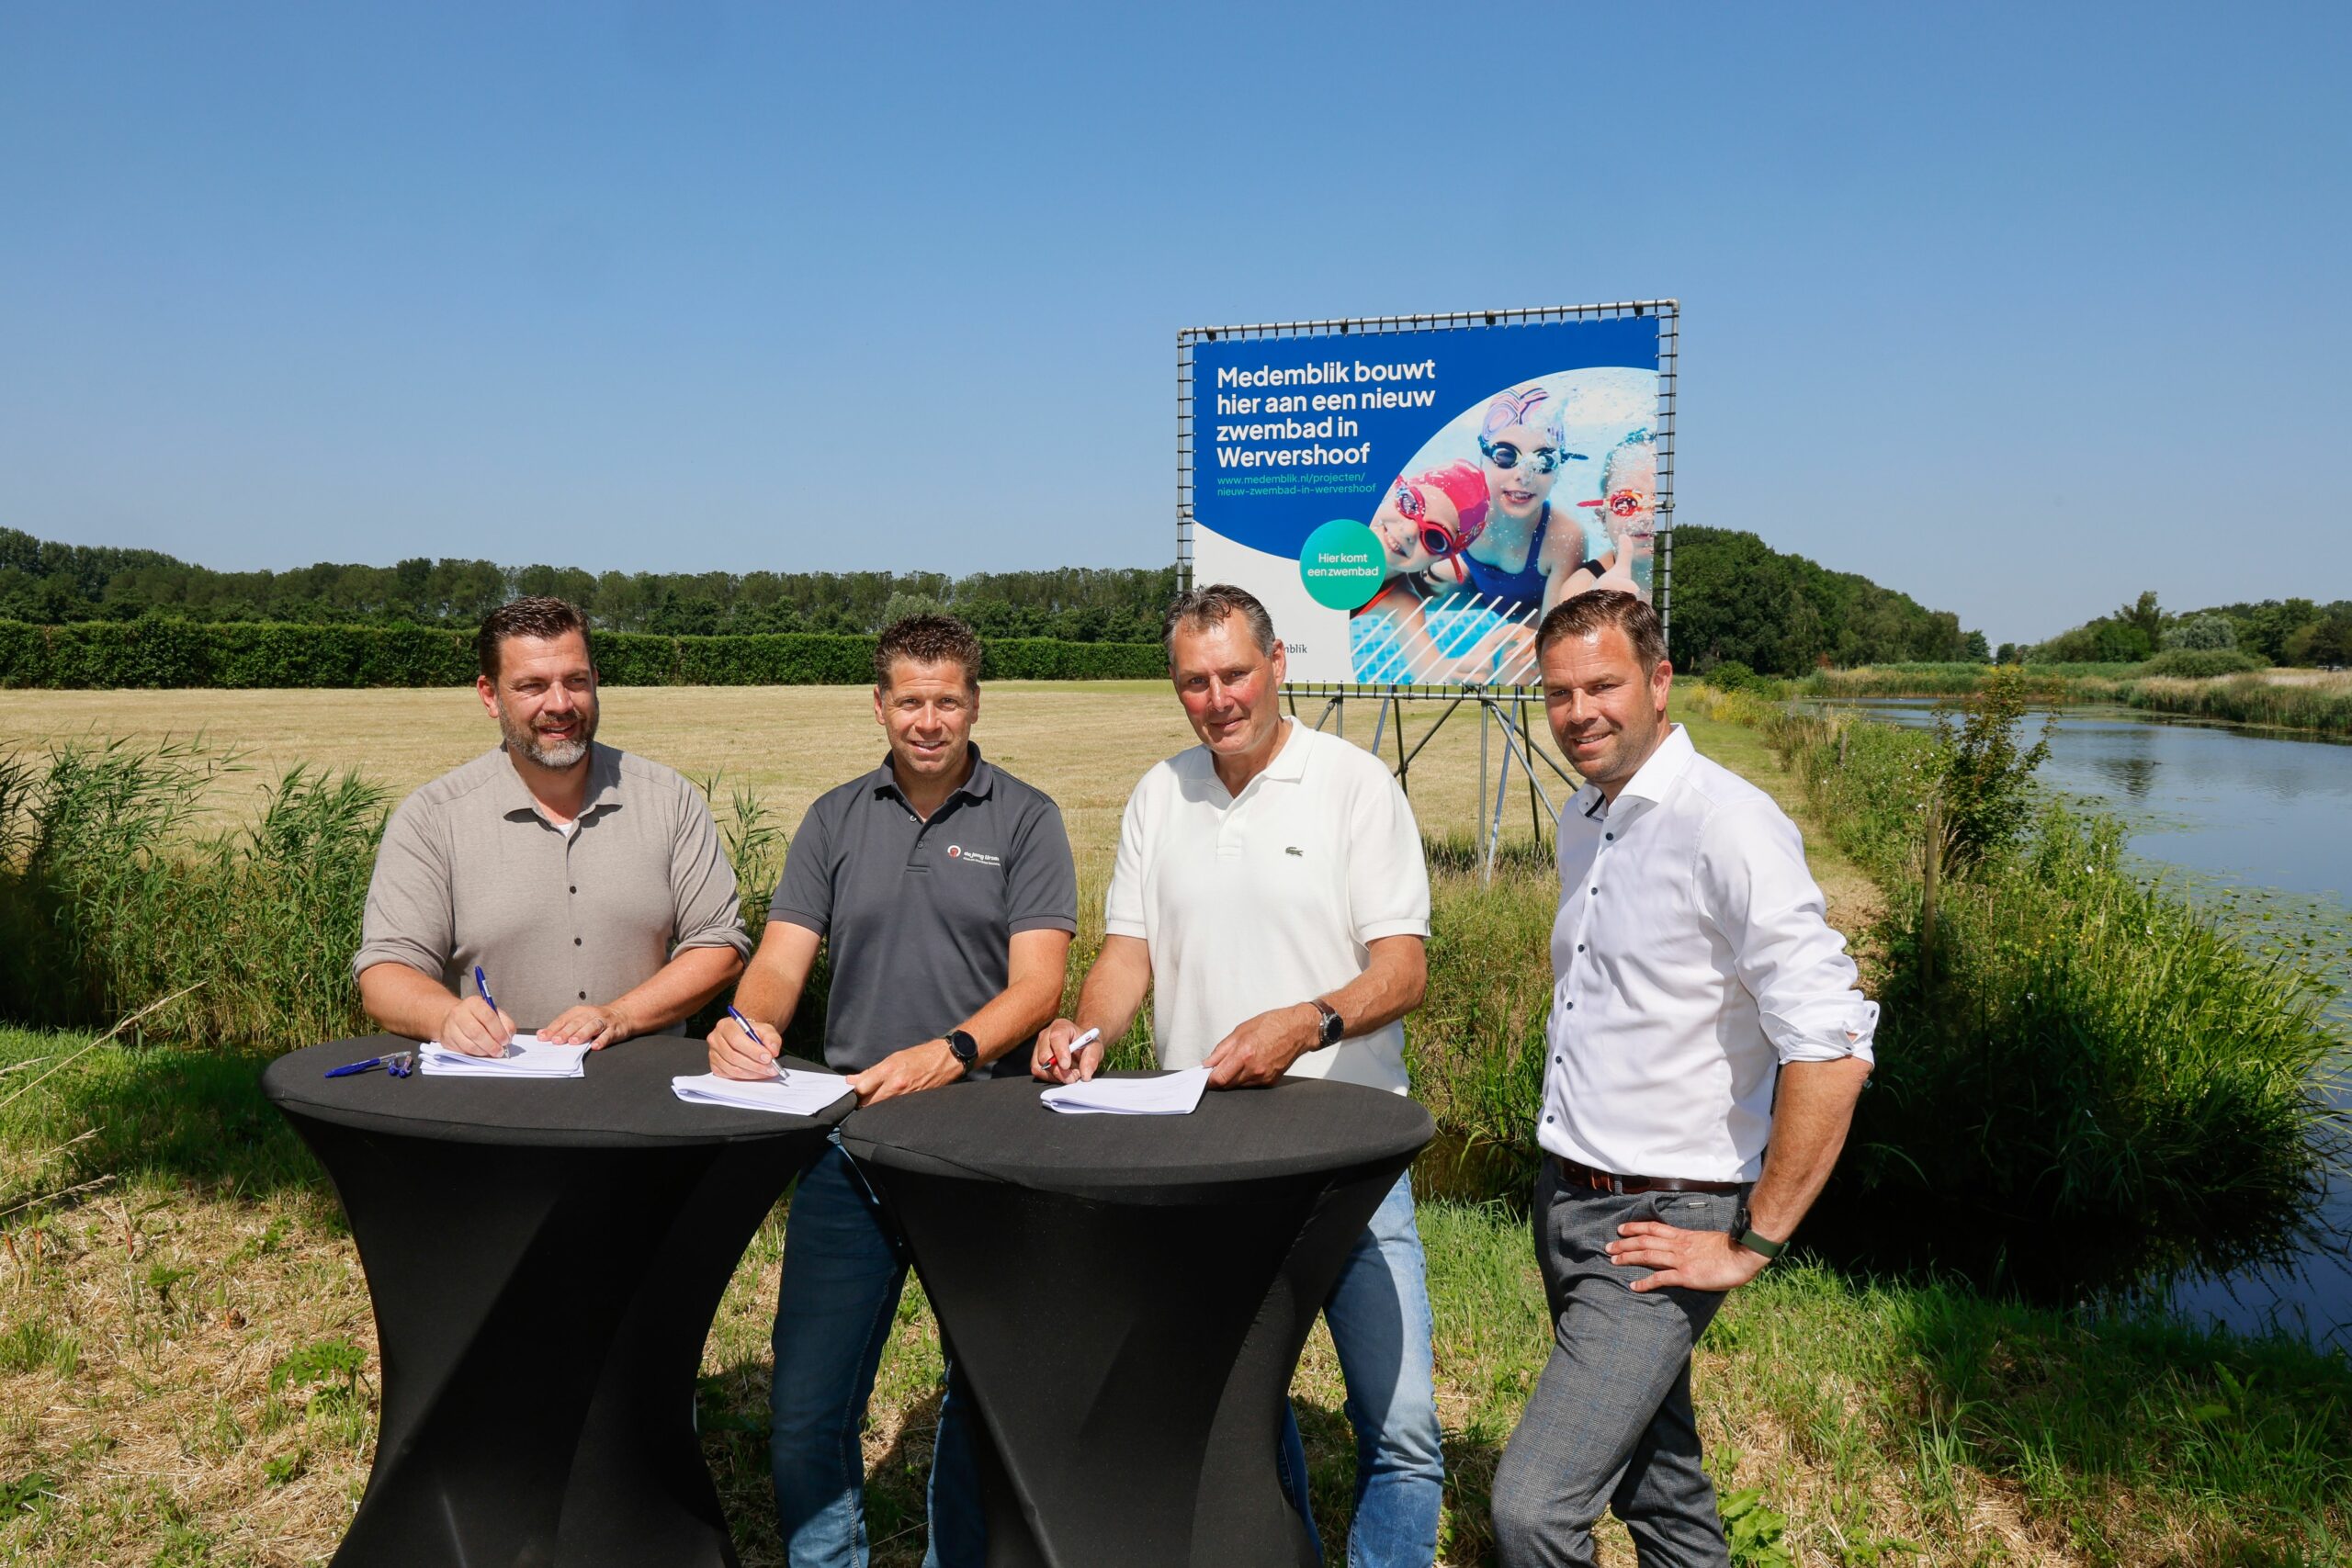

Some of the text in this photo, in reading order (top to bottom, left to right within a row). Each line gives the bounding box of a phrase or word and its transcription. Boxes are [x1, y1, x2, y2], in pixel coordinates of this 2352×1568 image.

[1217, 359, 1435, 388] Medemblik bouwt
[1217, 388, 1435, 414] hier aan een nieuw
[1216, 416, 1358, 441] zwembad in
[1216, 442, 1370, 468] Wervershoof
[1217, 472, 1365, 485] www.medemblik.nl/projecten/
[1217, 483, 1376, 496] nieuw-zwembad-in-wervershoof
[1318, 553, 1368, 563] Hier komt
[1307, 566, 1379, 577] een zwembad
